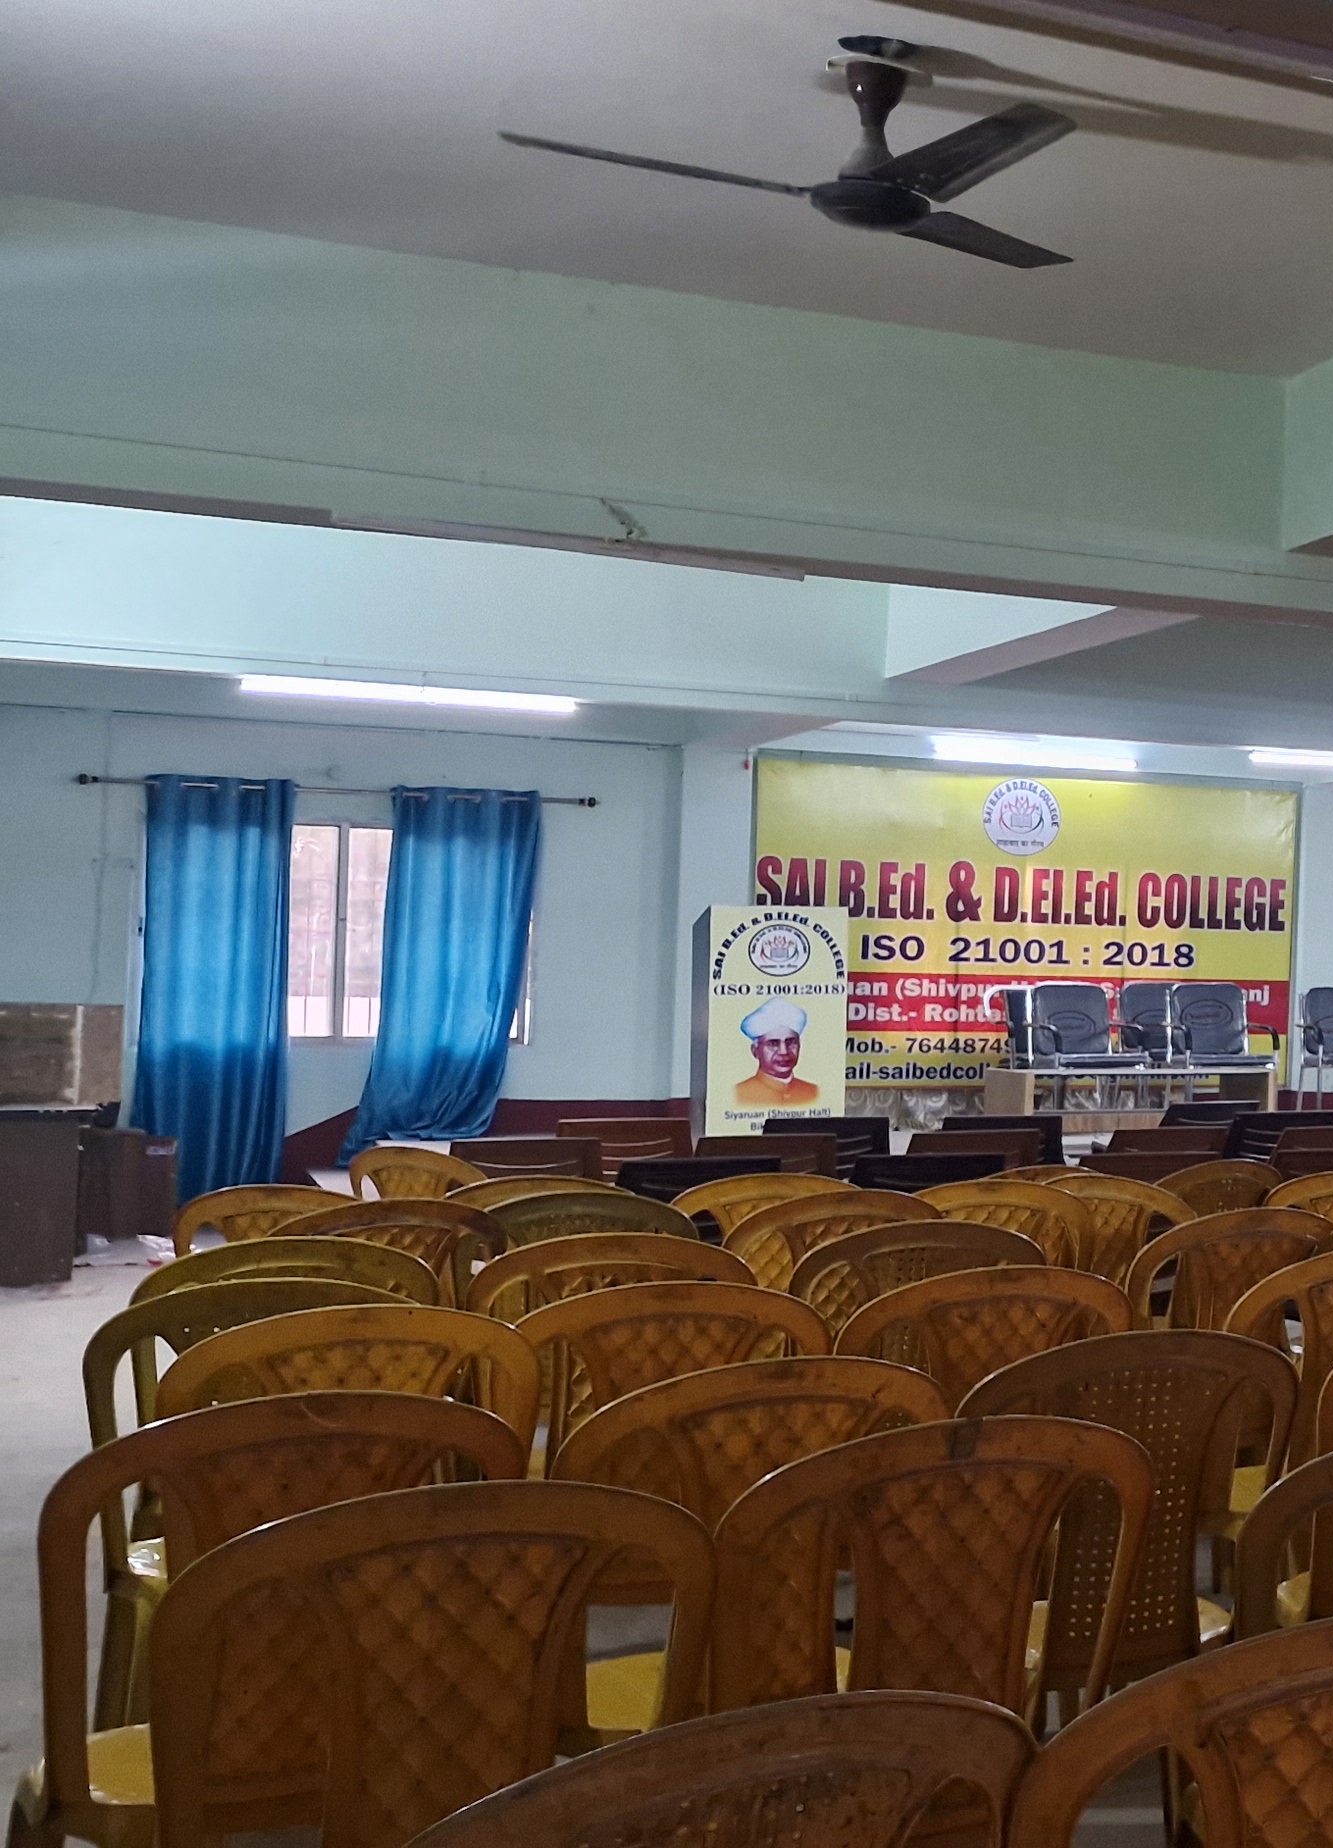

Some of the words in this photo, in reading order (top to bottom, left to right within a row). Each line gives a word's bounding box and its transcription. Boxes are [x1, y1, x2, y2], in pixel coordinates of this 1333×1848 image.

[1039, 789, 1060, 828] COLLEGE
[757, 856, 827, 906] SAI
[839, 860, 935, 920] B.Ed.
[946, 861, 983, 922] &
[1137, 872, 1287, 932] COLLEGE
[712, 951, 726, 980] SAI
[812, 923, 845, 979] COLLEGE
[861, 934, 925, 961] ISO
[948, 937, 1071, 965] 21001
[1102, 941, 1195, 968] 2018
[713, 983, 751, 996] (ISO
[756, 983, 846, 995] 21001:2018)
[724, 1110, 765, 1121] Siyaruan
[809, 1108, 831, 1118] Halt)
